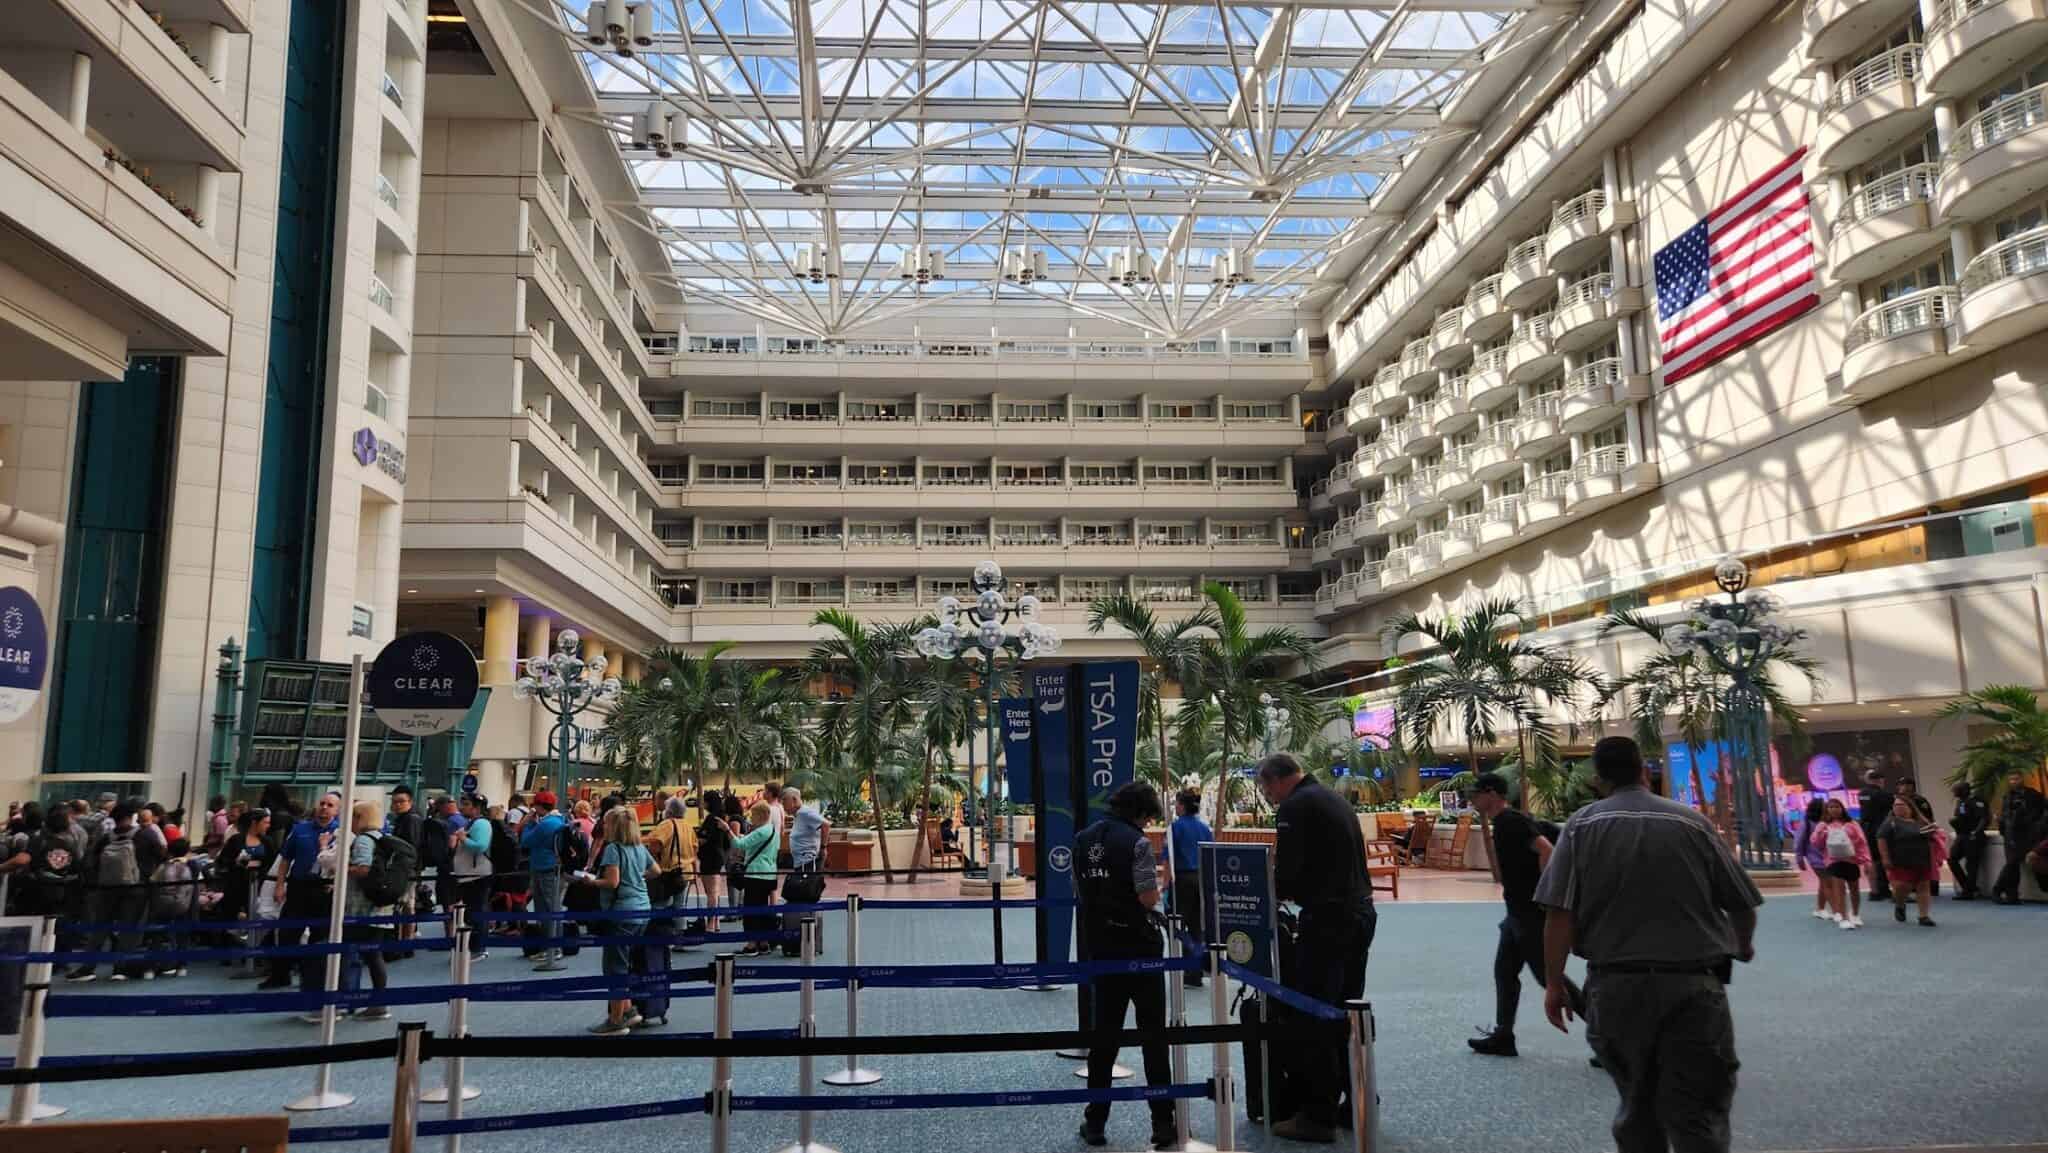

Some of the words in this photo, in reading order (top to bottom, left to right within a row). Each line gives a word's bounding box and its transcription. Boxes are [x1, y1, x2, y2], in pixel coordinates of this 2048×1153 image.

[0, 647, 31, 665] LEAR
[394, 678, 453, 689] CLEAR
[1035, 675, 1064, 686] Enter
[1040, 686, 1064, 697] Here
[1090, 673, 1116, 731] TSA
[1006, 709, 1030, 718] Enter
[1009, 718, 1032, 727] Here
[1092, 738, 1117, 787] Pre
[1220, 874, 1249, 883] CLEAR
